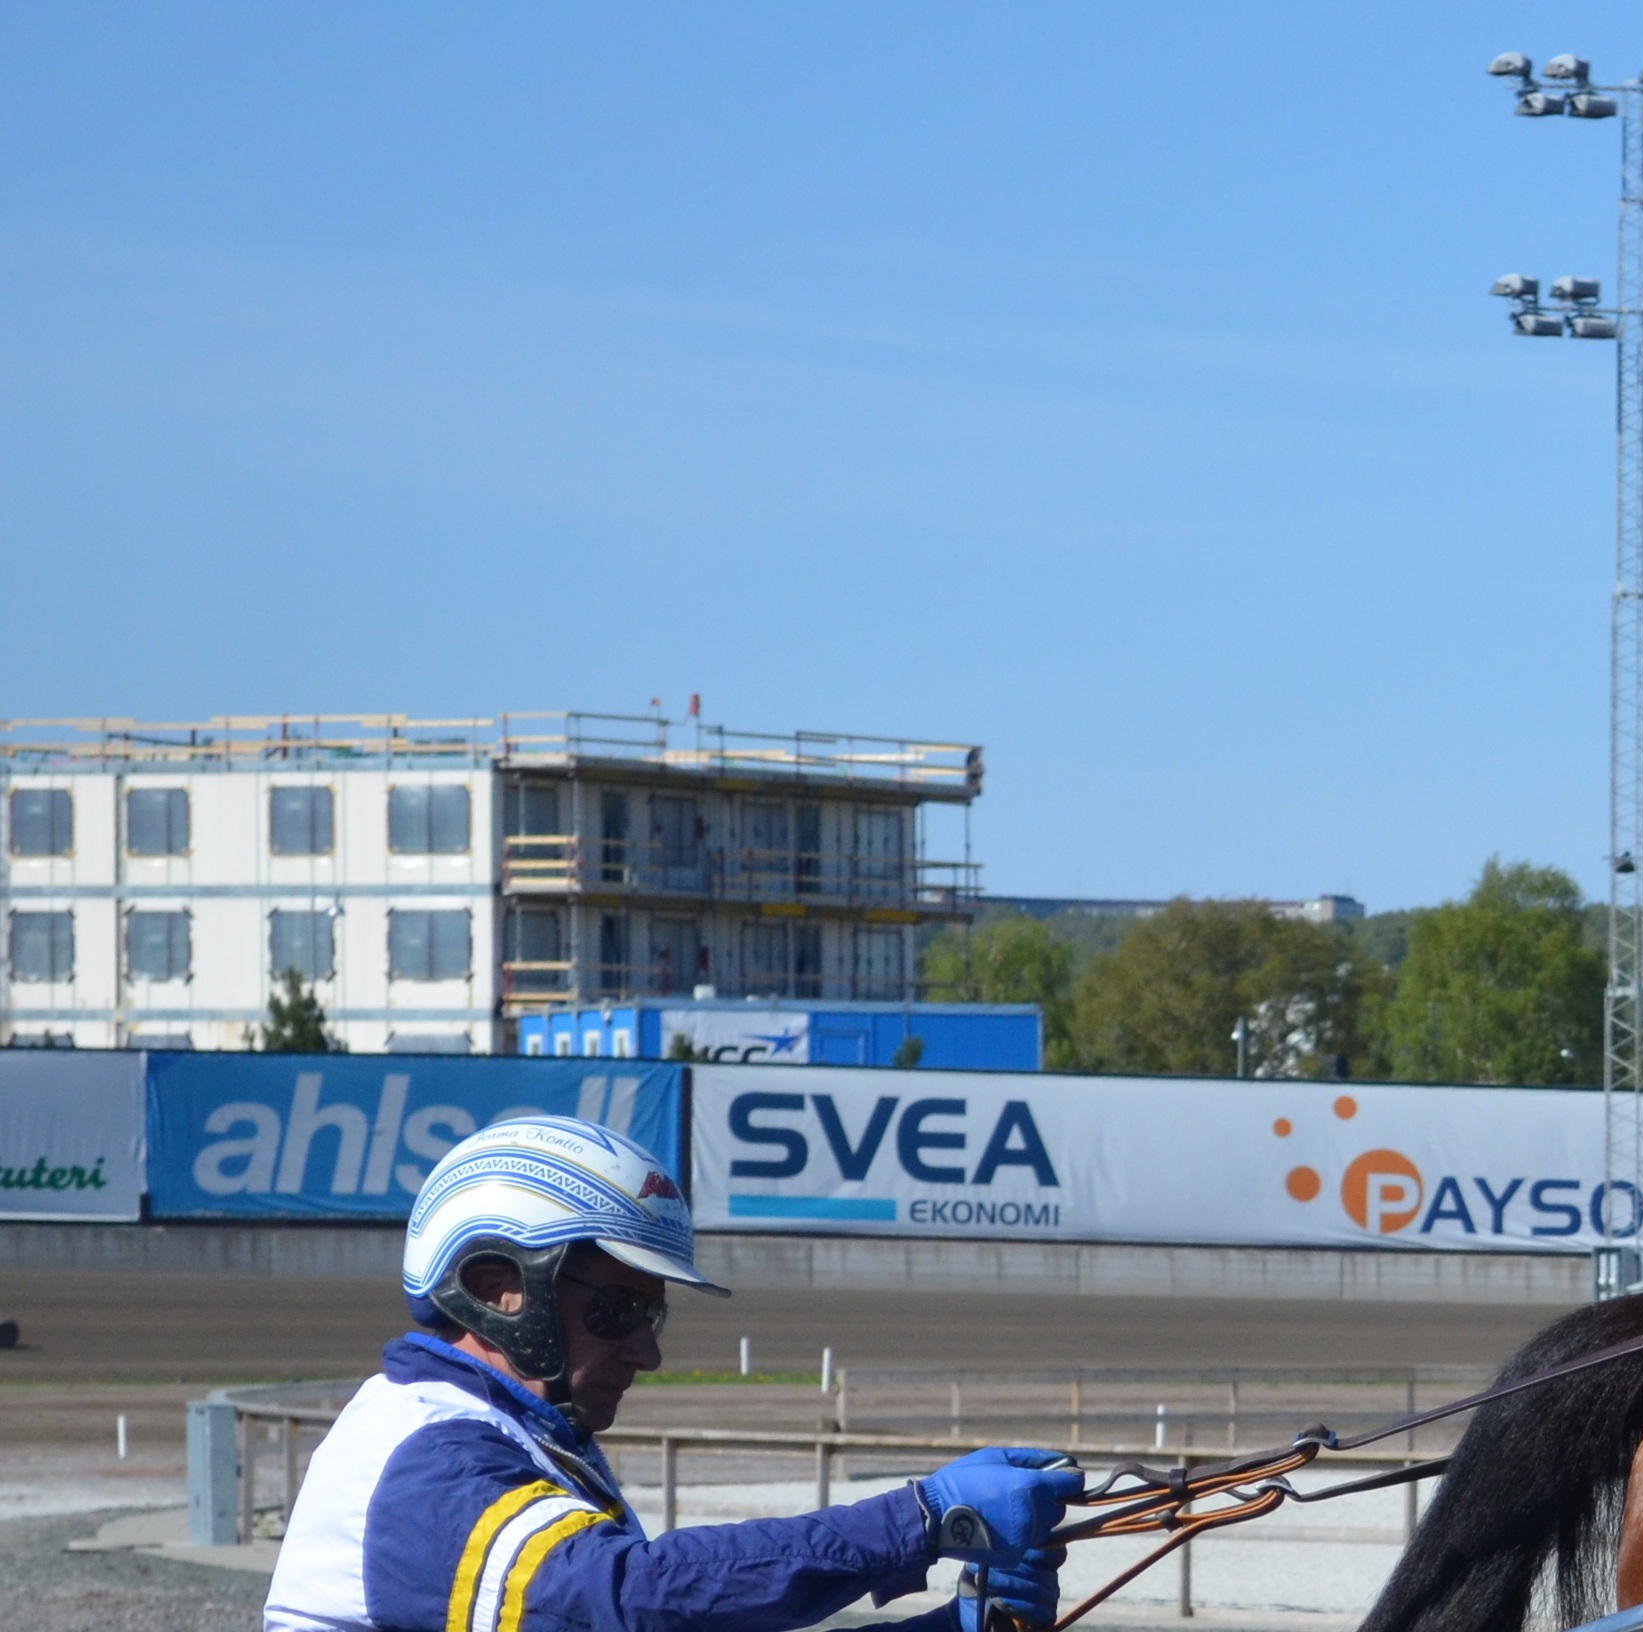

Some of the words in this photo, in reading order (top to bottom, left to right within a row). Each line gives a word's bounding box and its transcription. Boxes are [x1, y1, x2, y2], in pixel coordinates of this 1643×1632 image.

[193, 1073, 639, 1195] ahlsl
[526, 1127, 584, 1154] Kontio
[728, 1092, 1060, 1187] SVEA
[0, 1156, 107, 1190] uteri
[909, 1200, 1060, 1227] EKONOMI
